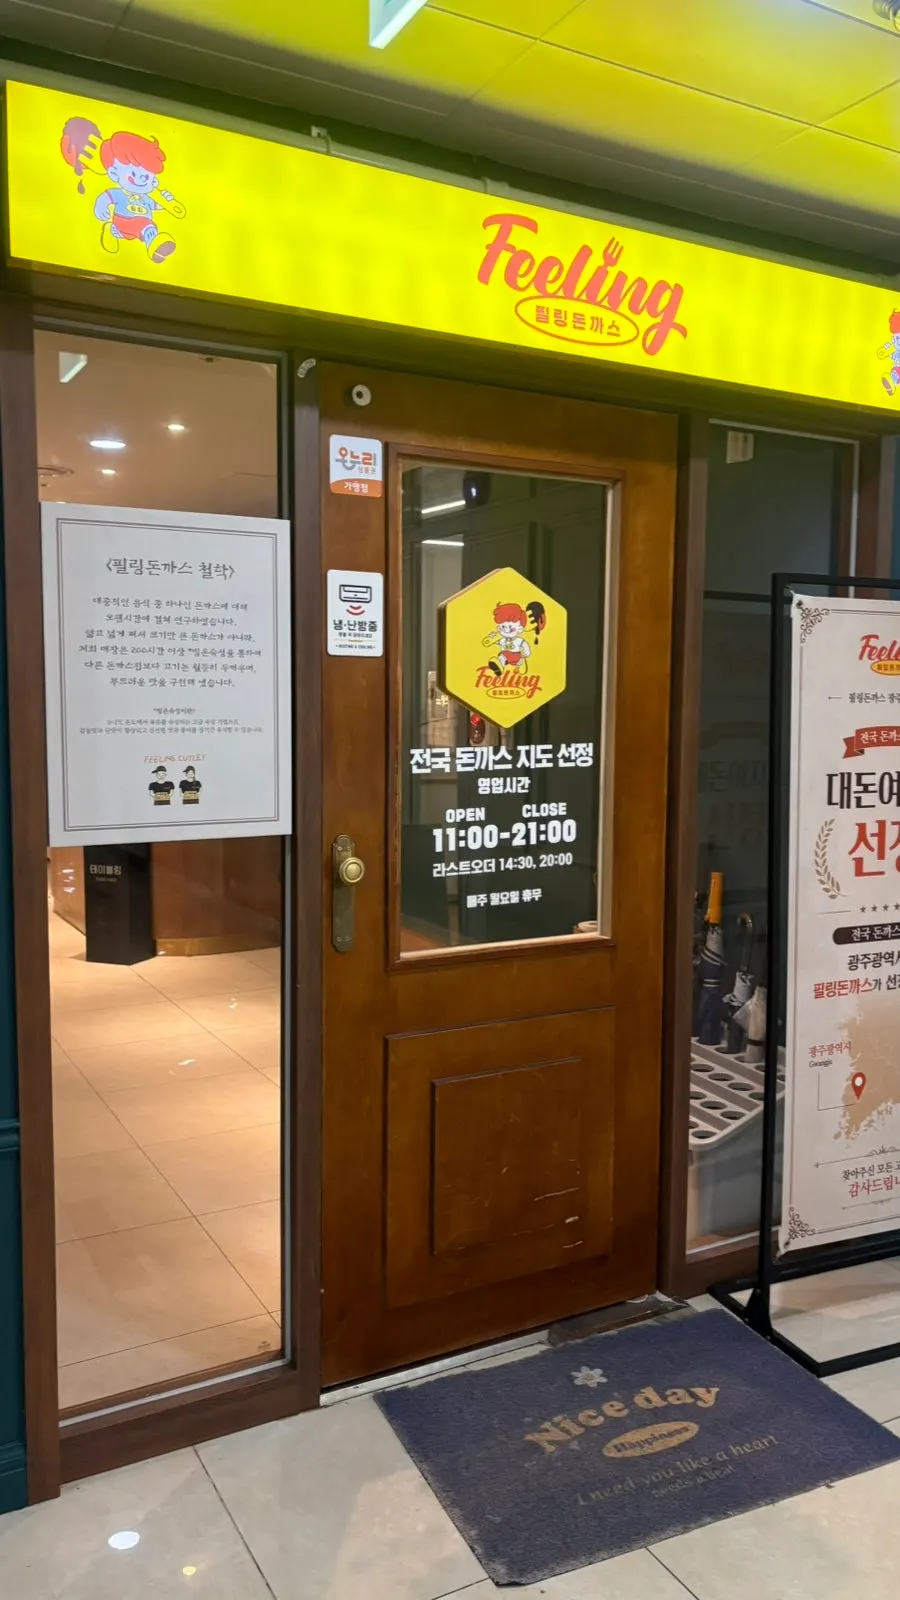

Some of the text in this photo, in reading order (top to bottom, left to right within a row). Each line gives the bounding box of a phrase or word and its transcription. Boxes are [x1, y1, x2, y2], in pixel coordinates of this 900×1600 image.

[477, 213, 688, 356] Feeling
[535, 304, 621, 338] 필링돈까스
[344, 481, 368, 493] 가맹점
[475, 665, 542, 699] Feeling
[849, 692, 887, 704] 필링돈까스
[860, 731, 878, 744] 전국
[409, 742, 594, 774] 전국 돈까스 지도 선정
[477, 776, 531, 795] 영업시간
[445, 803, 567, 823] OPEN CLOSE
[433, 819, 577, 852] 11:00-21:00
[432, 853, 573, 878] 라스트오더 14:30, 20:00
[466, 888, 542, 908] 매주 월요일 휴무
[851, 927, 871, 941] 전국
[814, 974, 900, 999] 필링돈까스가 선
[808, 1041, 852, 1058] 광주광역시
[843, 1164, 875, 1181] 찾아주신
[876, 1161, 893, 1174] 모든
[524, 1386, 720, 1453] Nice day
[613, 1426, 690, 1454] Happiness
[590, 1477, 637, 1500] need
[641, 1467, 675, 1487] you
[676, 1456, 714, 1473] like
[716, 1451, 728, 1462] a
[729, 1435, 779, 1456] heart
